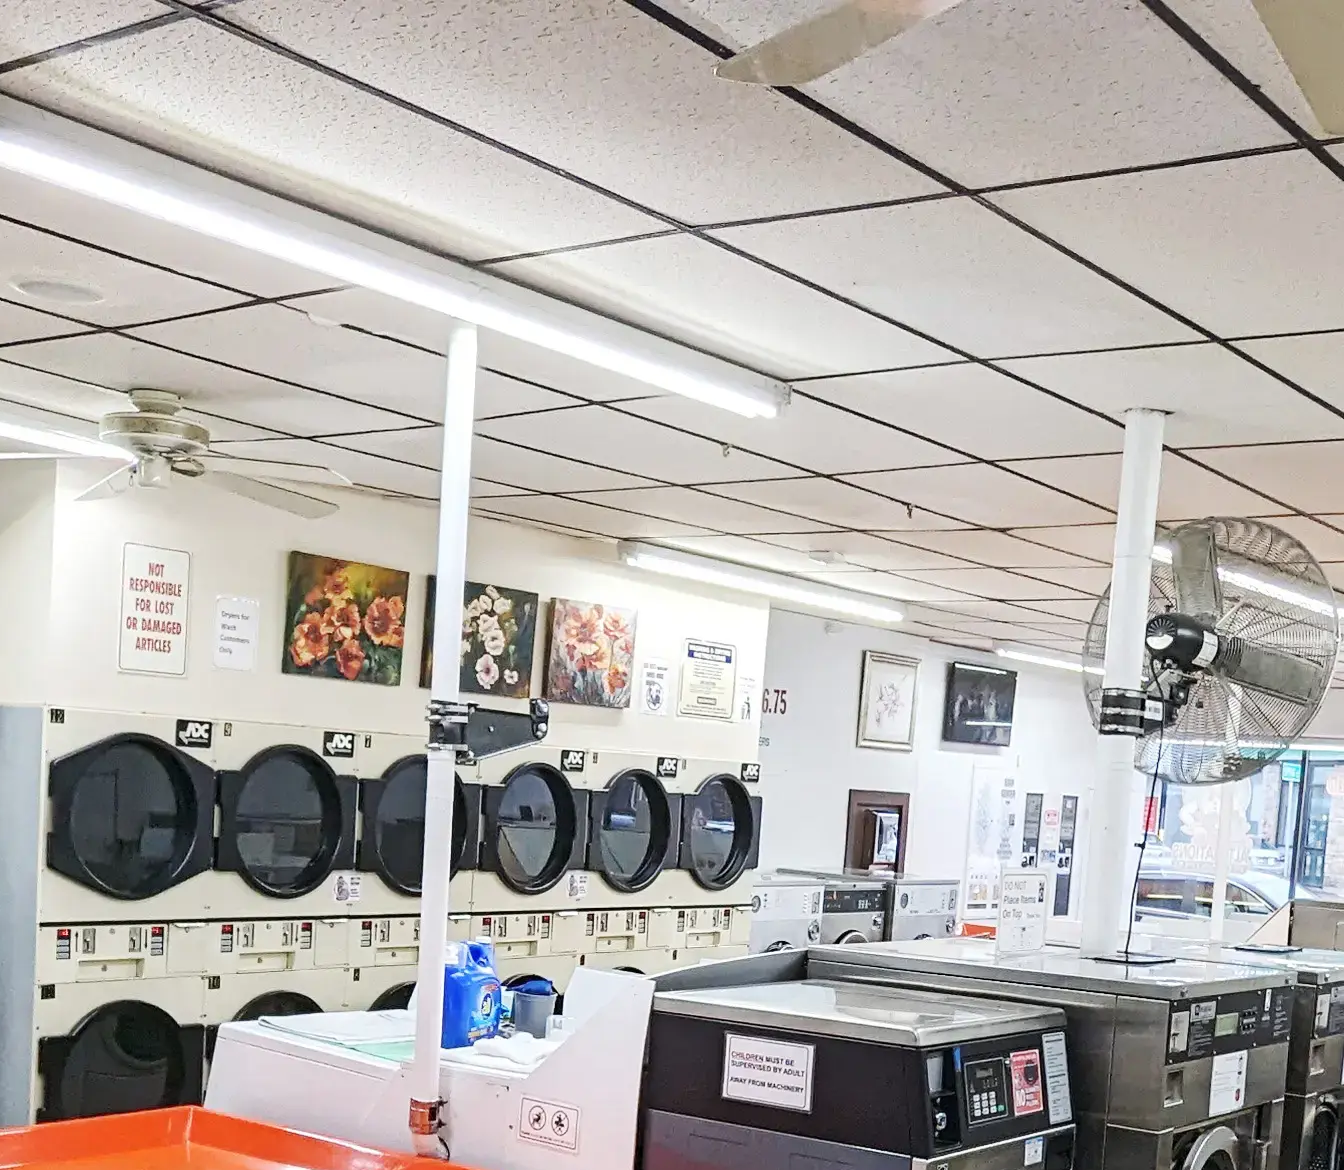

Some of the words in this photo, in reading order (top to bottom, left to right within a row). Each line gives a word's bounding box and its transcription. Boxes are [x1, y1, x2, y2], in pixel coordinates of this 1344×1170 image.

[148, 562, 165, 578] NOT
[129, 577, 182, 598] RESPONSIBLE
[135, 598, 152, 613] FOR
[155, 600, 174, 616] LOST
[126, 616, 139, 631] OR
[141, 617, 182, 636] DAMAGED
[135, 636, 172, 654] ARTICLES
[185, 721, 211, 740] ADC
[332, 733, 354, 750] ADC
[731, 1050, 764, 1063] CHILDREN
[765, 1055, 784, 1065] MUST
[785, 1057, 795, 1067] BE
[731, 1059, 772, 1073] SUPERVISED
[772, 1066, 782, 1074] BY
[783, 1068, 805, 1078] ADULT
[729, 1075, 747, 1085] AWAY
[747, 1078, 766, 1088] FROM
[767, 1081, 805, 1094] MACHINERY
